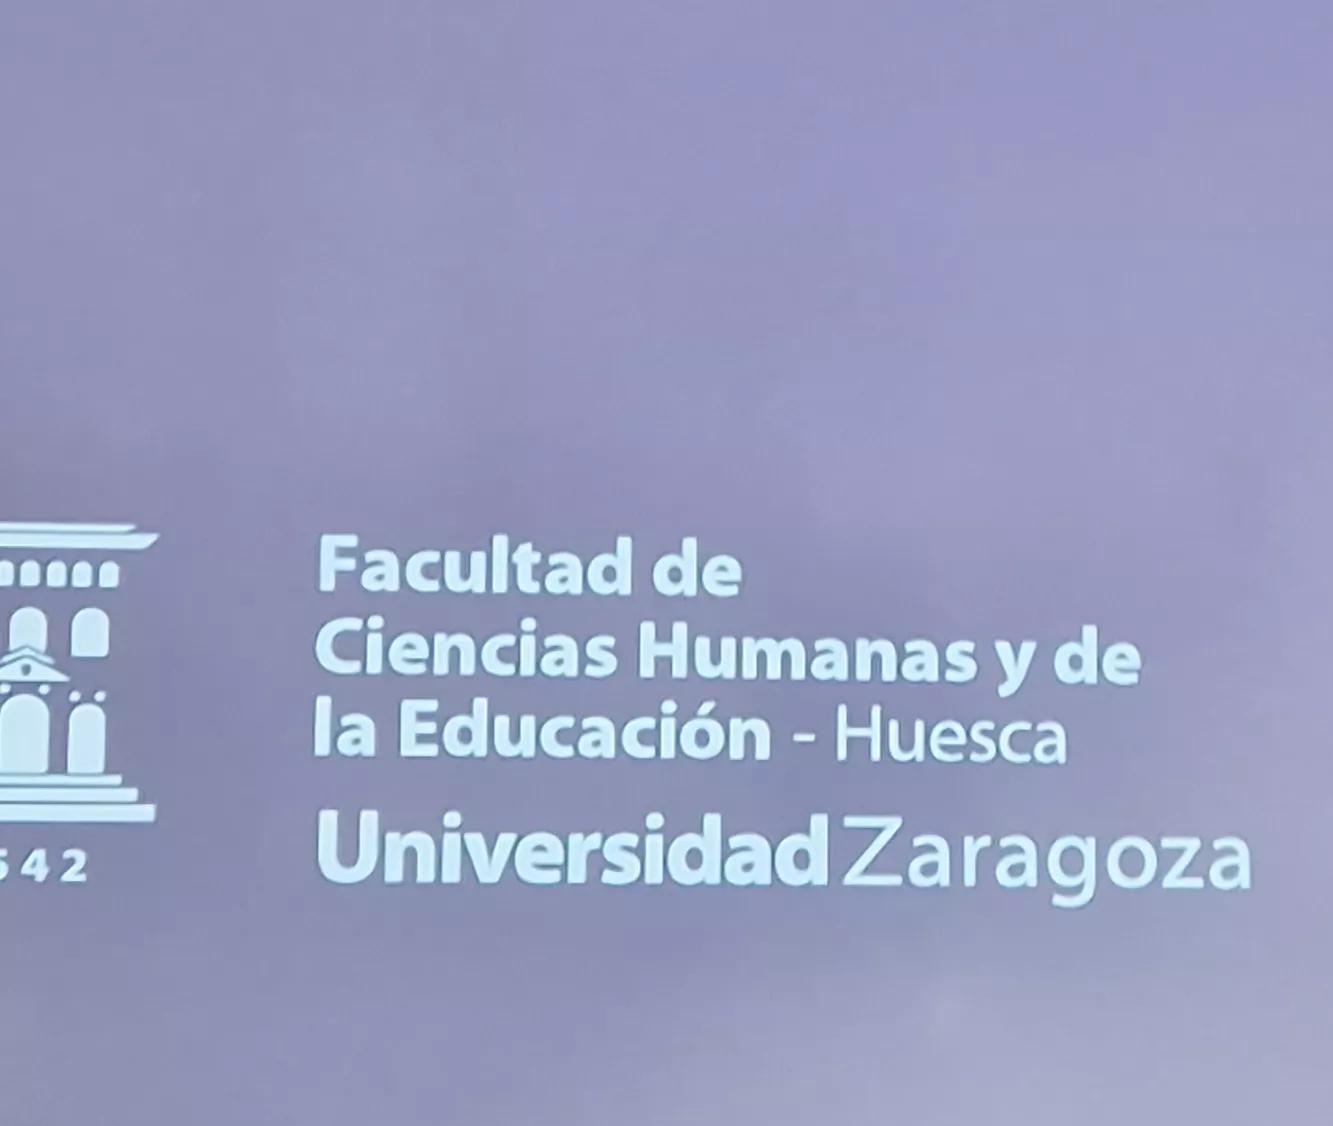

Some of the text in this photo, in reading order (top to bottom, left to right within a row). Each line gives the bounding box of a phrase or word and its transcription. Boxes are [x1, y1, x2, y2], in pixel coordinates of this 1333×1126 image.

[319, 534, 742, 597] Facultad de
[315, 615, 1141, 698] Ciencias Humanas y de
[314, 695, 376, 757] la
[400, 697, 771, 761] Educación
[837, 703, 1066, 764] Huesca
